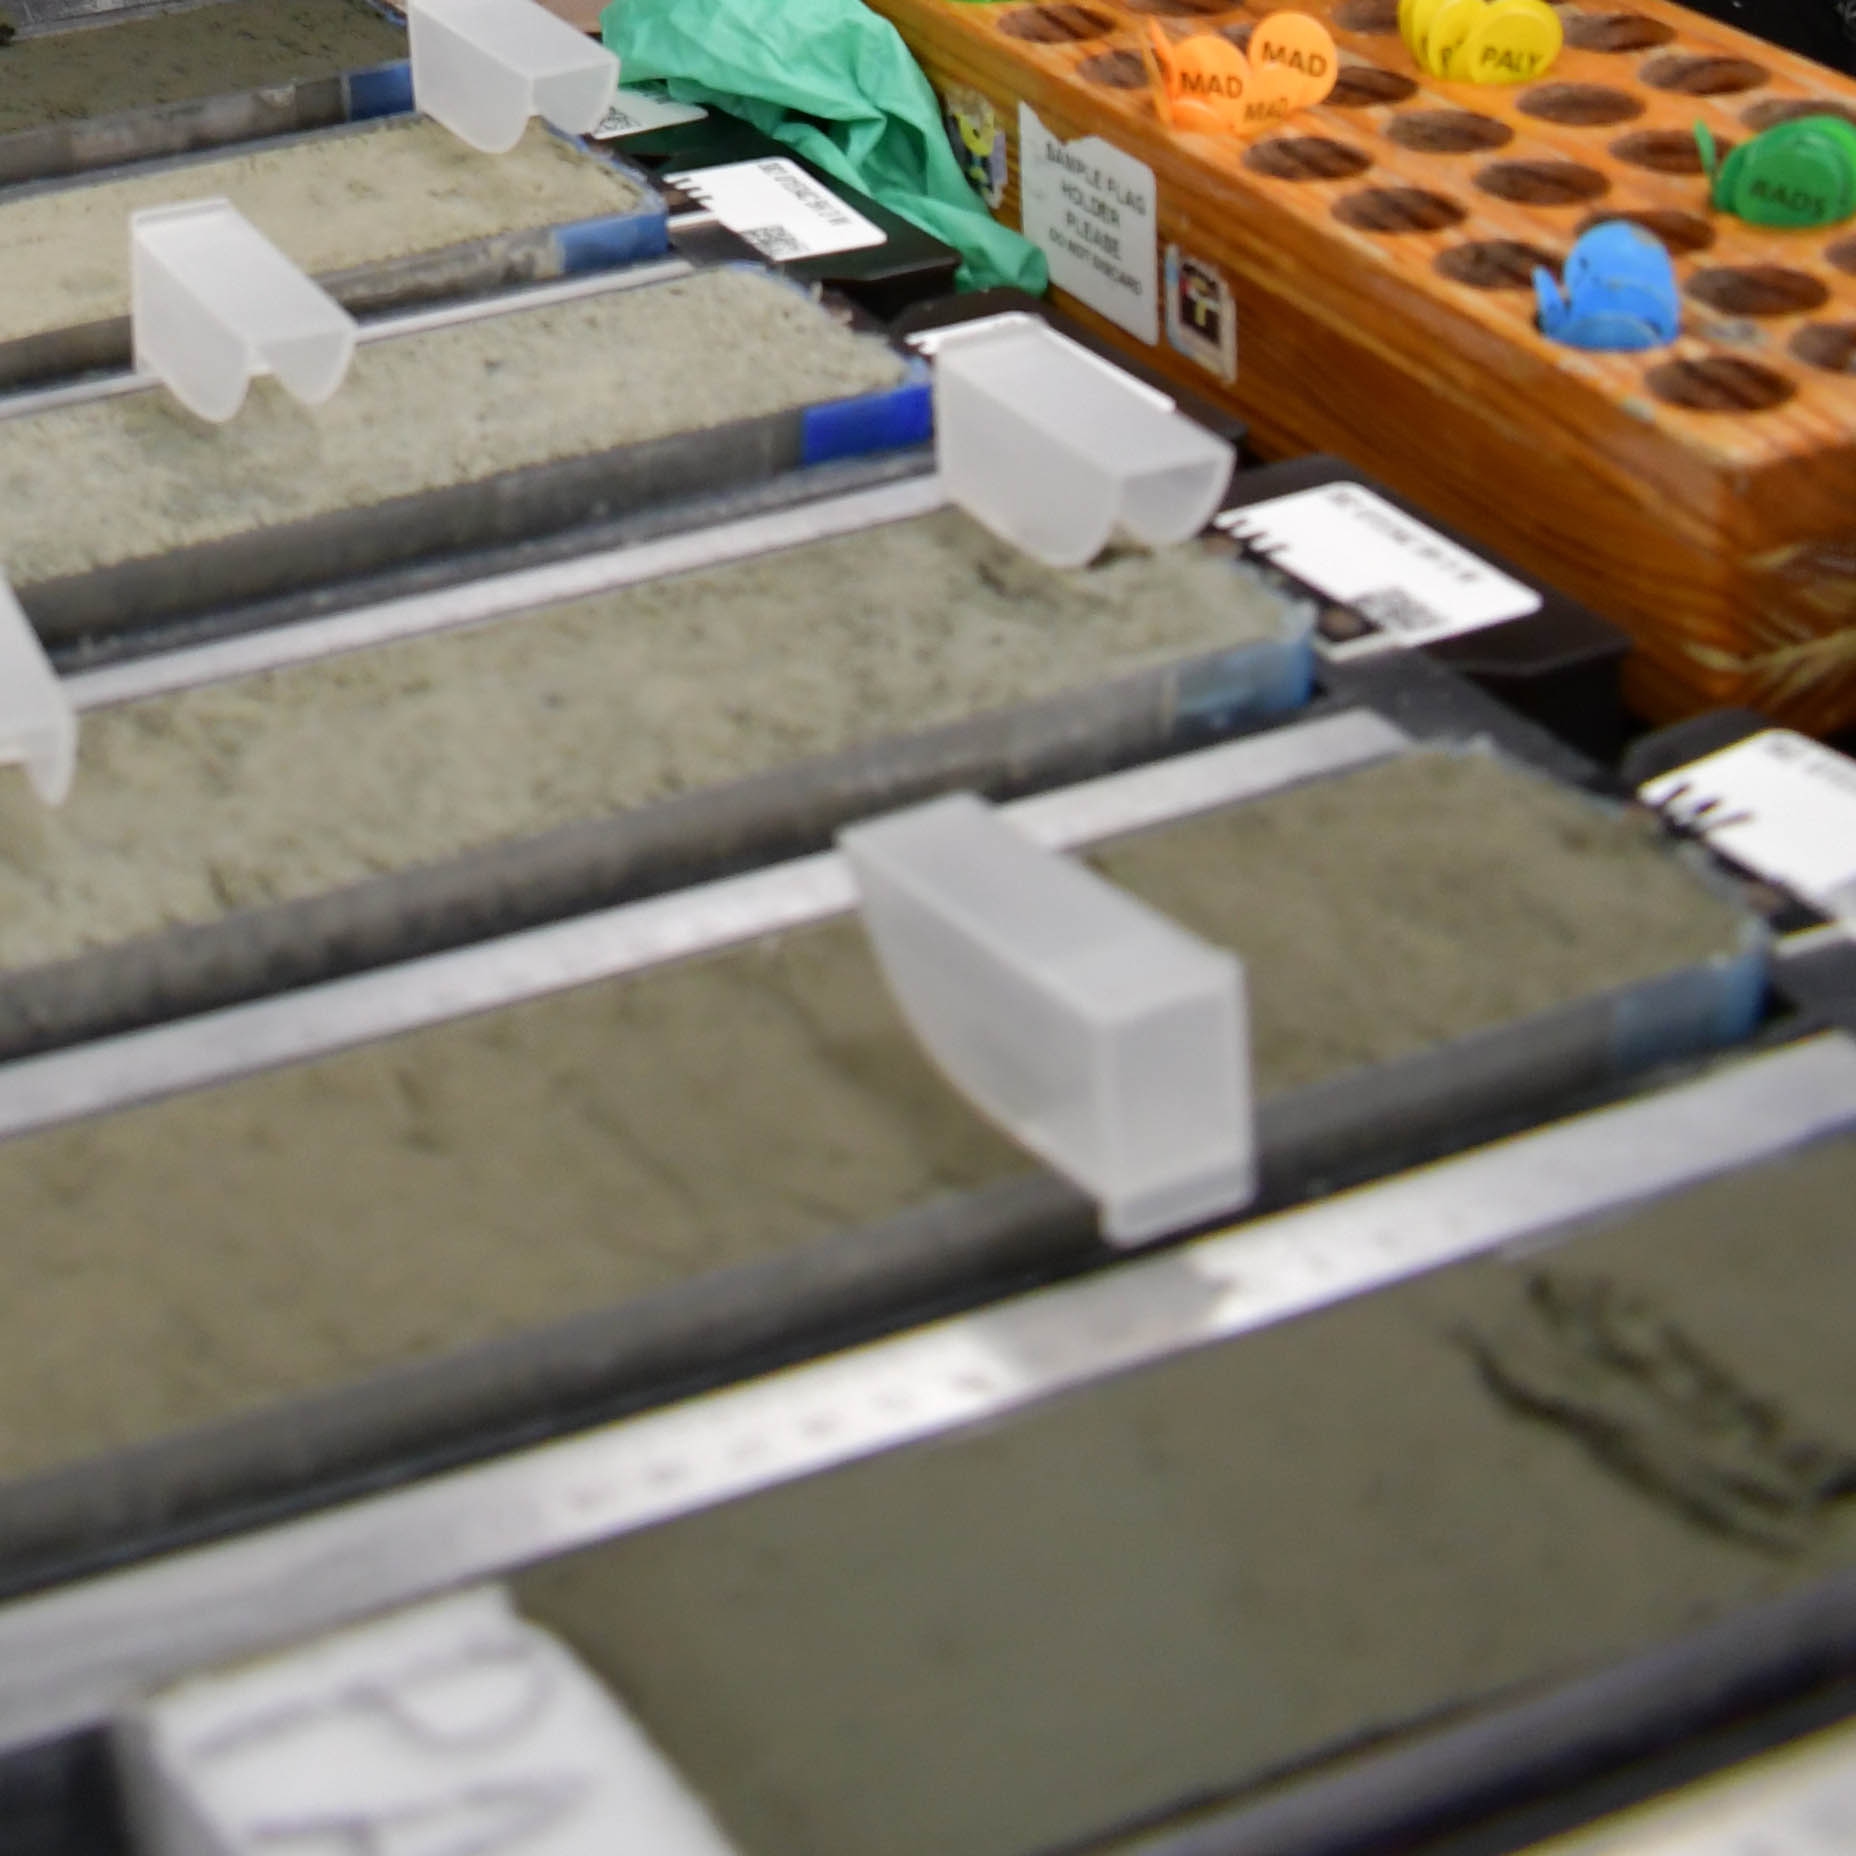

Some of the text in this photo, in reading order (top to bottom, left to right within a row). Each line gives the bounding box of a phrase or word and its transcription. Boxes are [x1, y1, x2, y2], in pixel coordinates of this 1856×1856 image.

[1261, 40, 1328, 79] MAD
[1480, 46, 1543, 74] PALY
[1179, 71, 1244, 100] MAD
